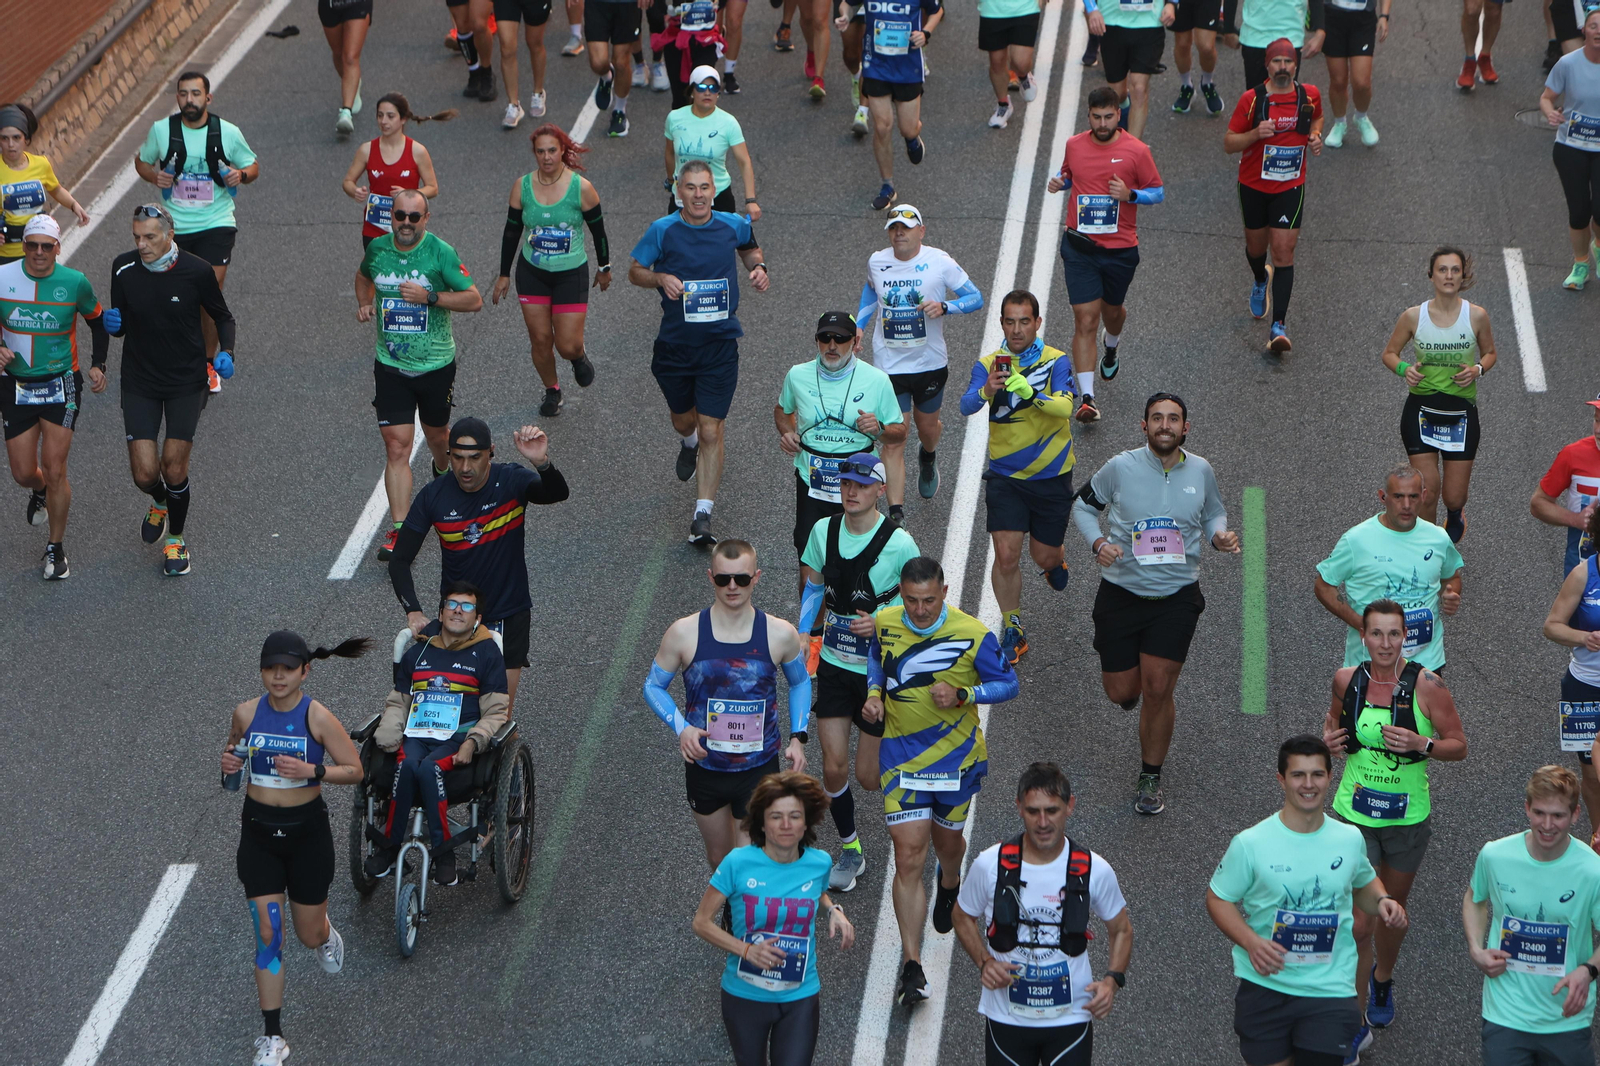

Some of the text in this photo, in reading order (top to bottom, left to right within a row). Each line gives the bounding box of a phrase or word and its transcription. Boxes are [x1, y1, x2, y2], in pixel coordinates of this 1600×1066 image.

[868, 2, 911, 14] DIGI
[16, 183, 38, 191] ZURICH
[882, 279, 922, 288] MADRID
[1425, 352, 1463, 362] sano
[815, 434, 855, 444] SEVILLA'24
[1432, 433, 1451, 441] ESTHER
[1150, 536, 1167, 544] 8343
[1404, 612, 1427, 621] URICH
[837, 633, 857, 643] 12994
[1404, 639, 1418, 647] AIME
[836, 644, 857, 653] GETHIN
[426, 694, 455, 703] ZURICH
[727, 722, 745, 730] 8011
[268, 738, 298, 749] ZURICH
[1358, 765, 1384, 774] gemeente
[1364, 773, 1400, 784] ermelo
[1367, 797, 1390, 810] 12885
[1298, 917, 1332, 925] ZURICH
[1524, 925, 1560, 935] ZURICH
[772, 940, 800, 949] URICH
[1520, 941, 1546, 953] 12400
[1518, 952, 1547, 963] REUBEN
[761, 969, 782, 979] ANITA
[1030, 966, 1063, 976] ZURICH
[1027, 986, 1053, 995] 12387
[1027, 998, 1054, 1006] FERENC
